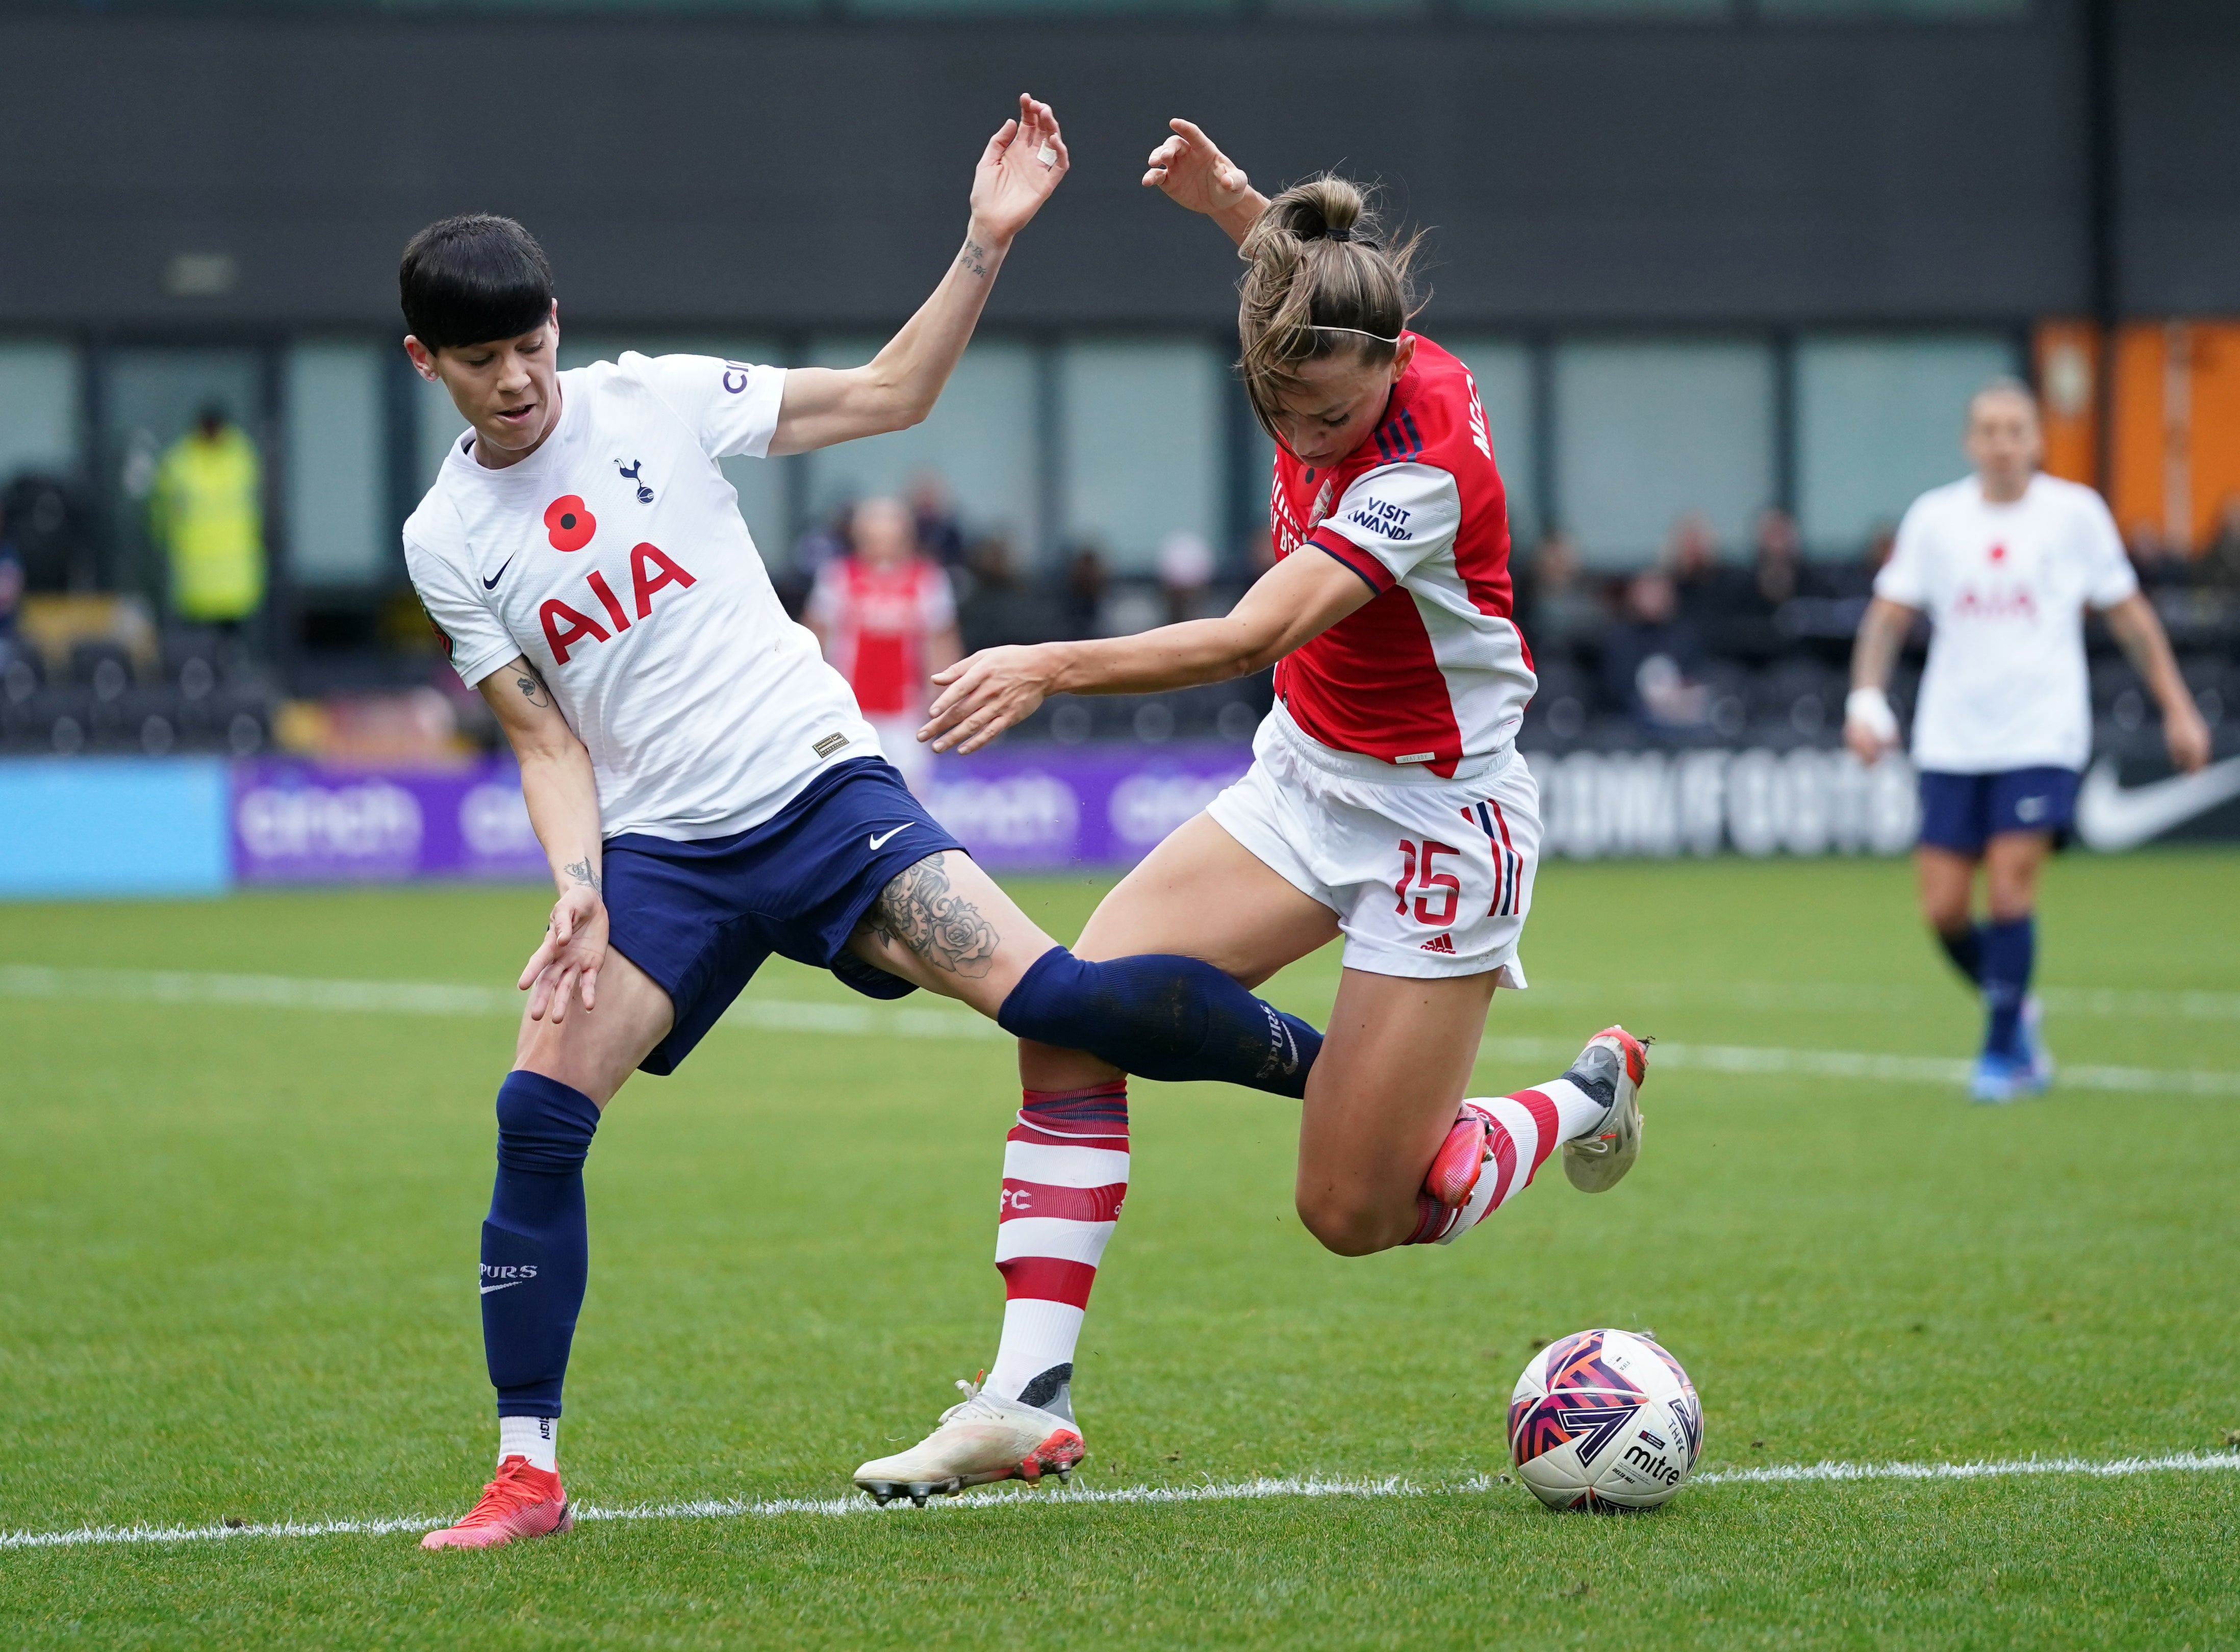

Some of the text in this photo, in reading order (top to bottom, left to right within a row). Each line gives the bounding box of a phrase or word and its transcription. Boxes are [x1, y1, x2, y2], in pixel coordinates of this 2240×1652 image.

[1345, 510, 1413, 540] WANDA
[1369, 497, 1411, 525] VISIT
[539, 543, 697, 665] AIA
[1395, 839, 1461, 926] 15
[1000, 1189, 1032, 1213] FC
[479, 1263, 538, 1278] PURS
[1612, 1468, 1626, 1478] DELTA
[1623, 1446, 1679, 1486] mitre
